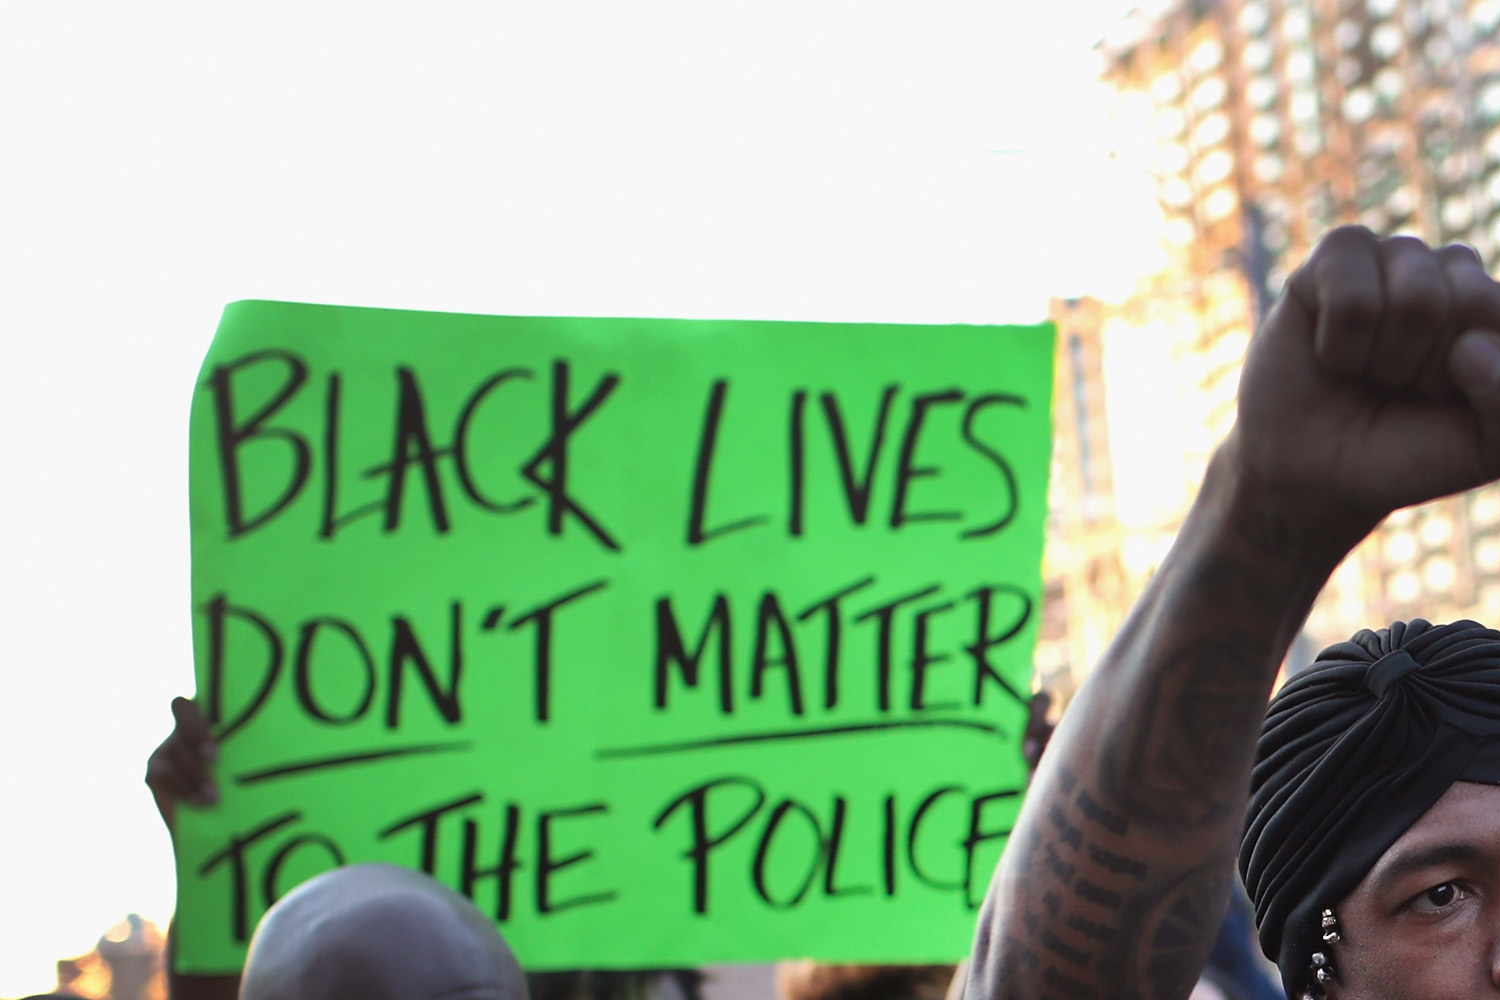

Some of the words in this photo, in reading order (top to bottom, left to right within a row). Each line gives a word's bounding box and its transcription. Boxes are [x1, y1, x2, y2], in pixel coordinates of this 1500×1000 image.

[207, 348, 623, 556] BLACK
[687, 376, 1030, 546] LIVES
[205, 577, 611, 743] DON'T
[653, 575, 1036, 718] MATTER
[378, 792, 619, 924] THE
[653, 774, 1023, 917] POLICE
